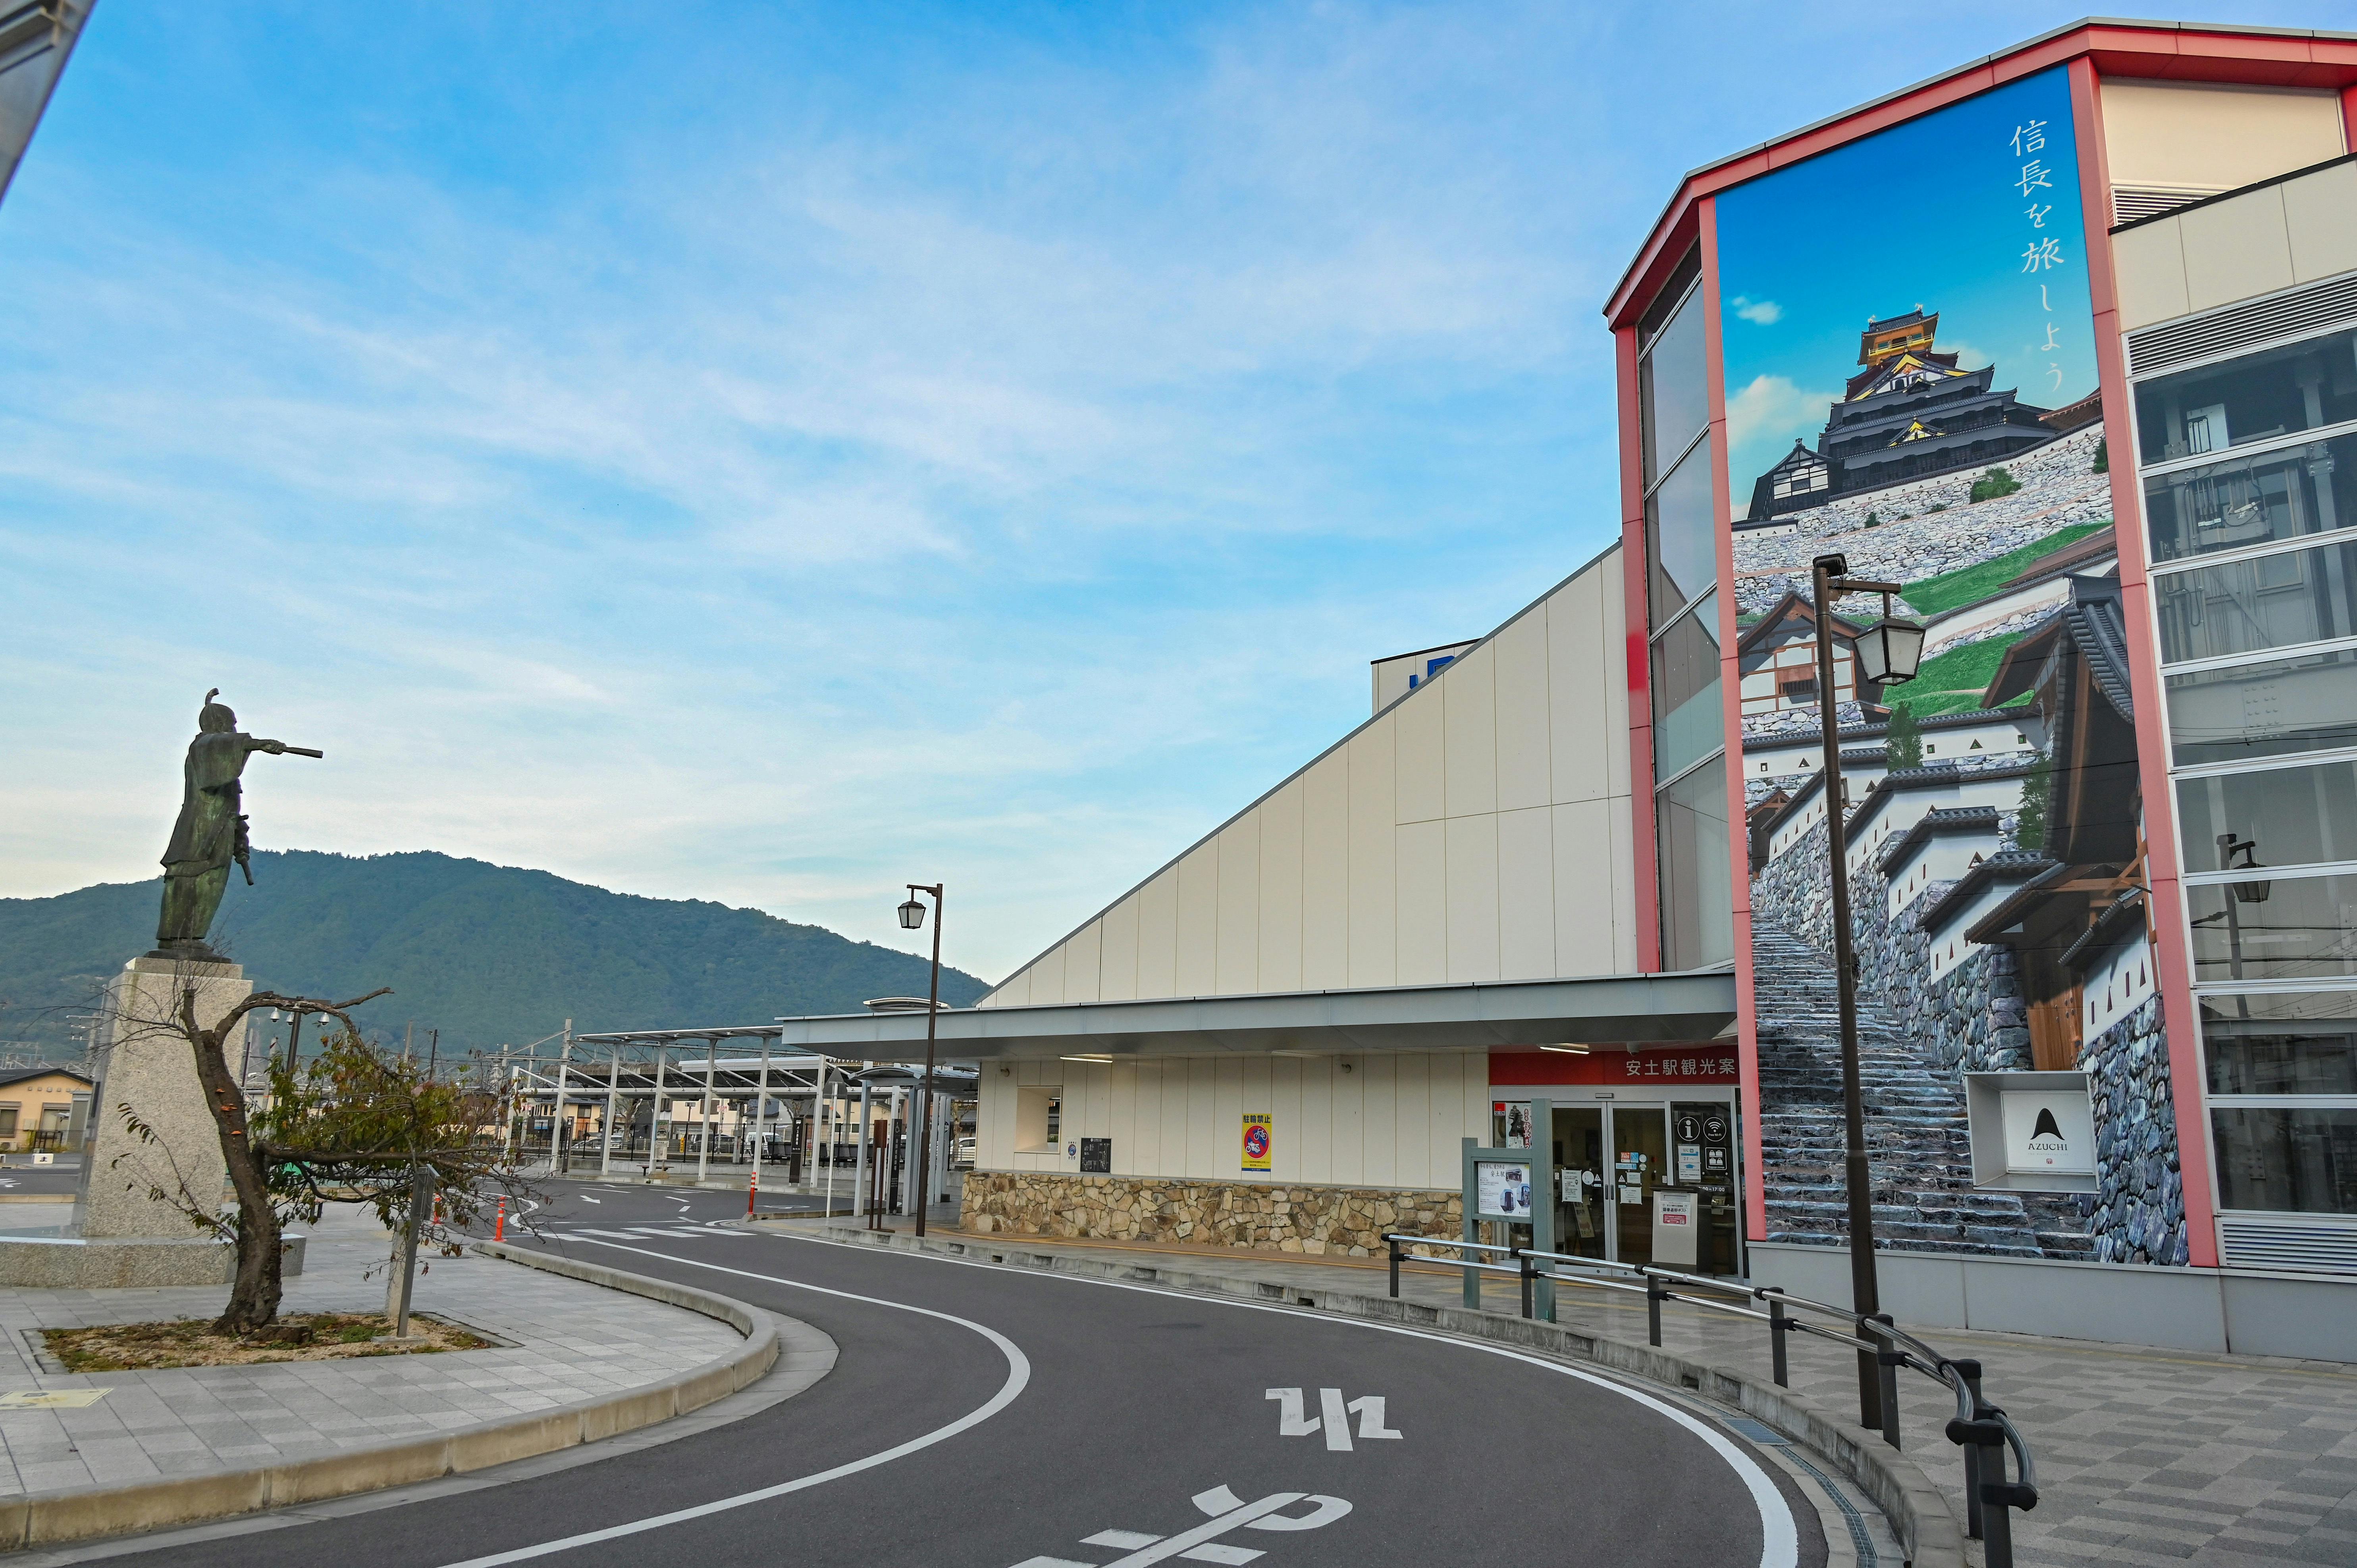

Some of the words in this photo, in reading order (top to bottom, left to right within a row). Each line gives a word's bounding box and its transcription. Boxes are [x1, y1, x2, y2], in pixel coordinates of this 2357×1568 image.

[2009, 119, 2064, 393] 信長を旅しよう
[1626, 1058, 1736, 1077] 安土駅観光案
